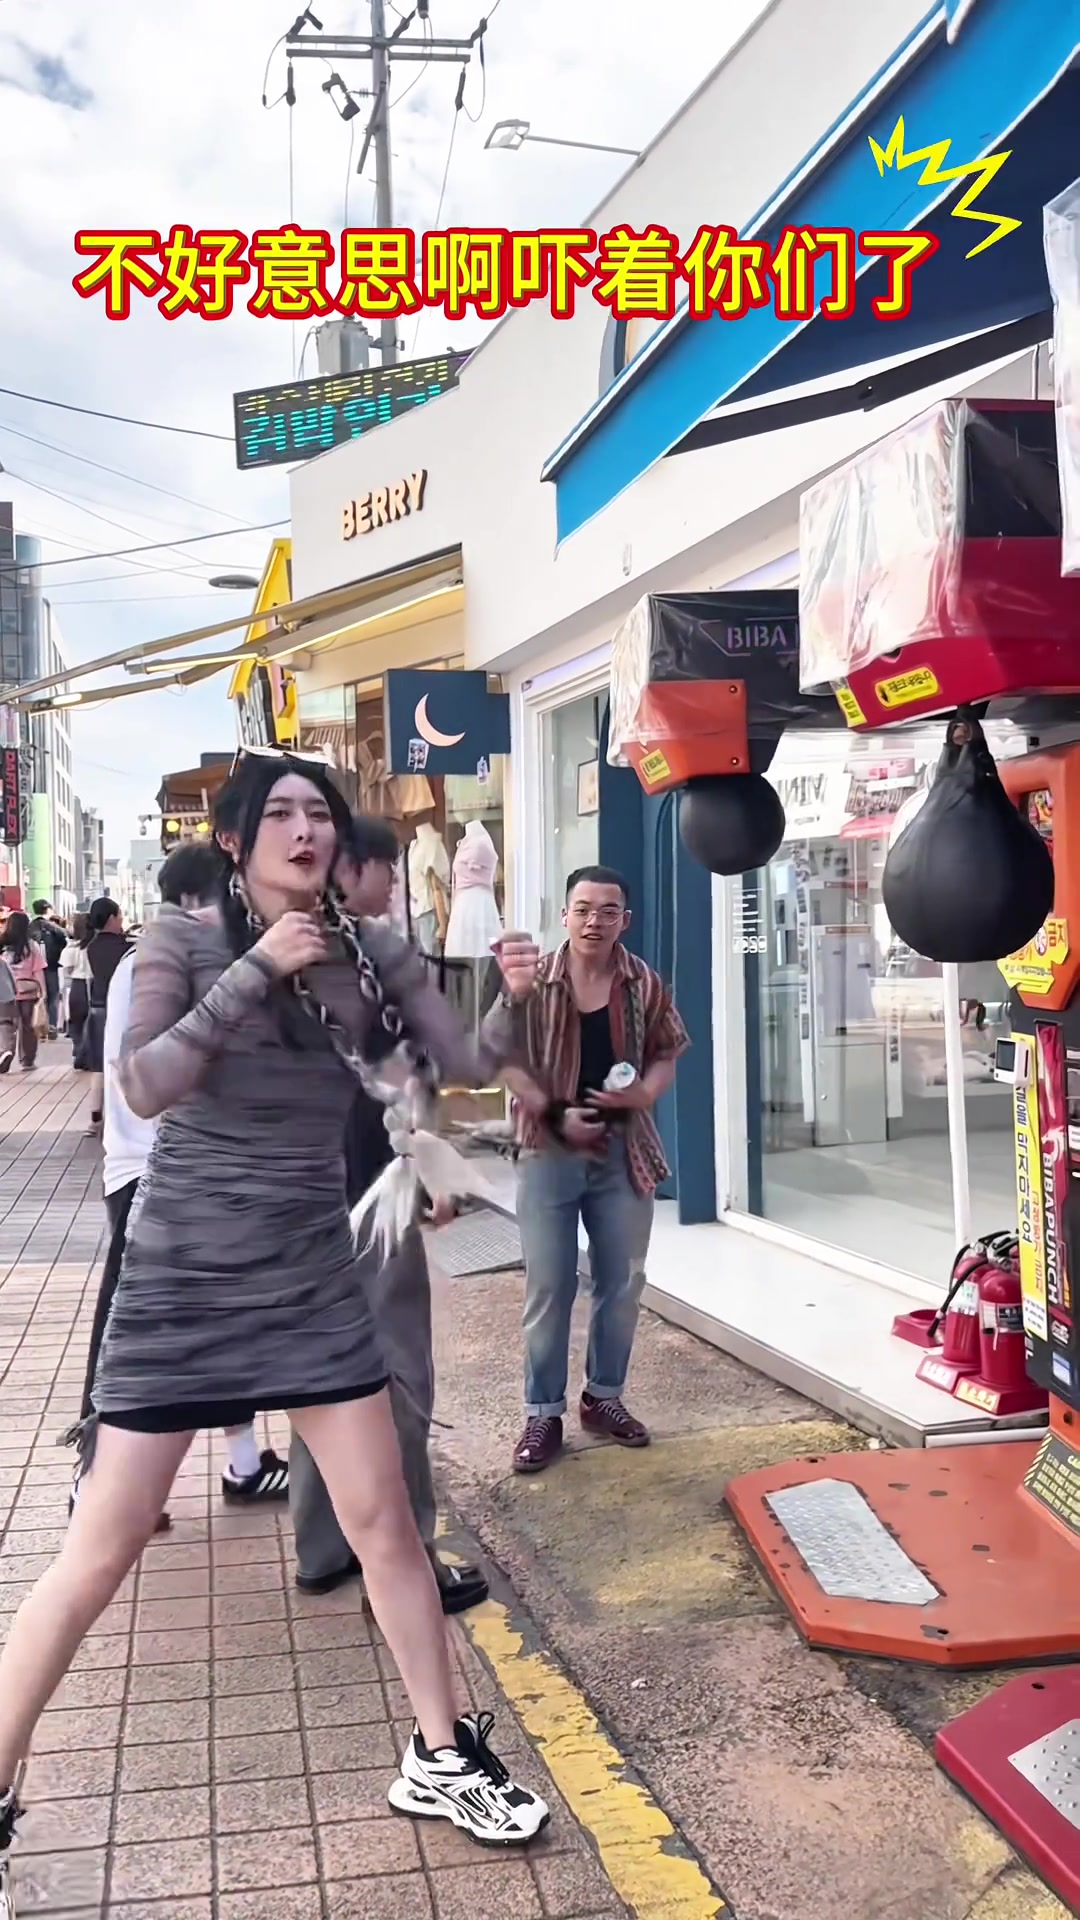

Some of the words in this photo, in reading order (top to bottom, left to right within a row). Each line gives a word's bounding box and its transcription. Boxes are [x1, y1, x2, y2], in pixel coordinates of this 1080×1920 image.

[342, 467, 428, 541] BERRY
[727, 624, 788, 649] BIBA
[1042, 1155, 1058, 1306] BIBAPUNCH
